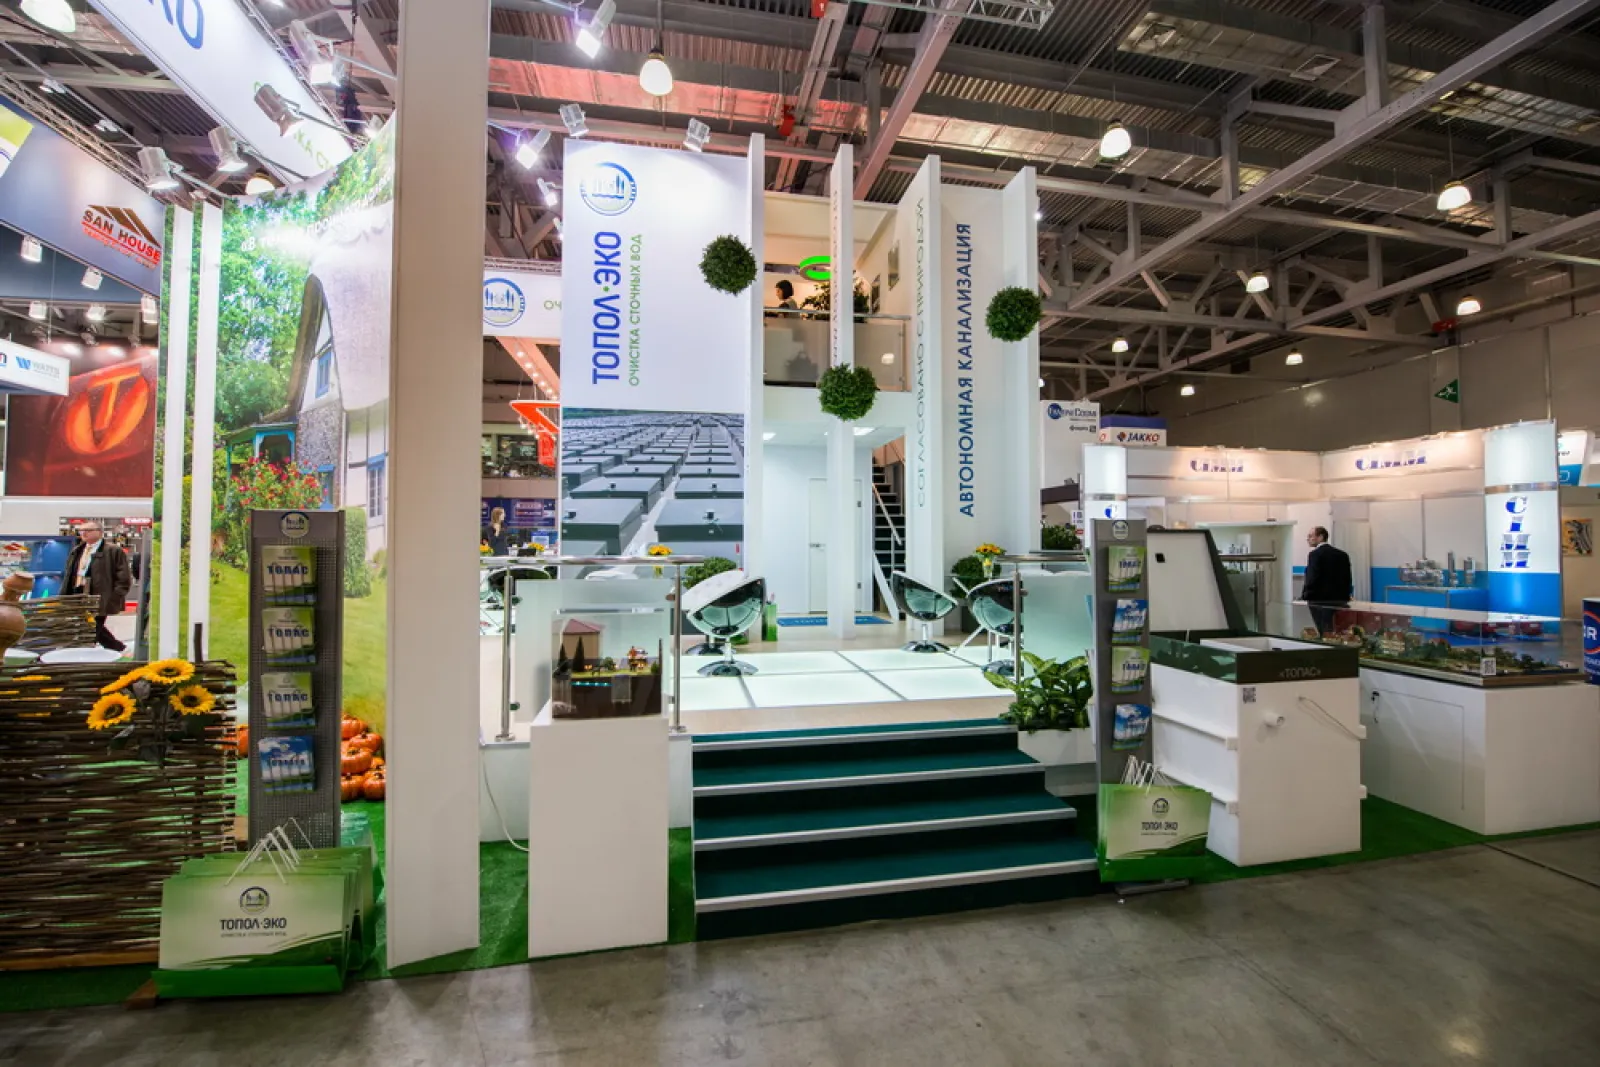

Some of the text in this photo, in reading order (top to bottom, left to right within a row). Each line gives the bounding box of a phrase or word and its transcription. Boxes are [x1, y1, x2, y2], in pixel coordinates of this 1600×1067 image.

[82, 210, 114, 235] SAN
[118, 229, 161, 262] HOUSE
[629, 233, 643, 387] ОЧИСТКА СТОЧНЫХ ВОД
[916, 197, 925, 508] СОГЛАСОВАНО С ПРИРОДОЙ
[957, 223, 974, 518] АВТОНОМНАЯ КАНАЛИЗАЦИЯ
[1127, 432, 1160, 442] JAKKO
